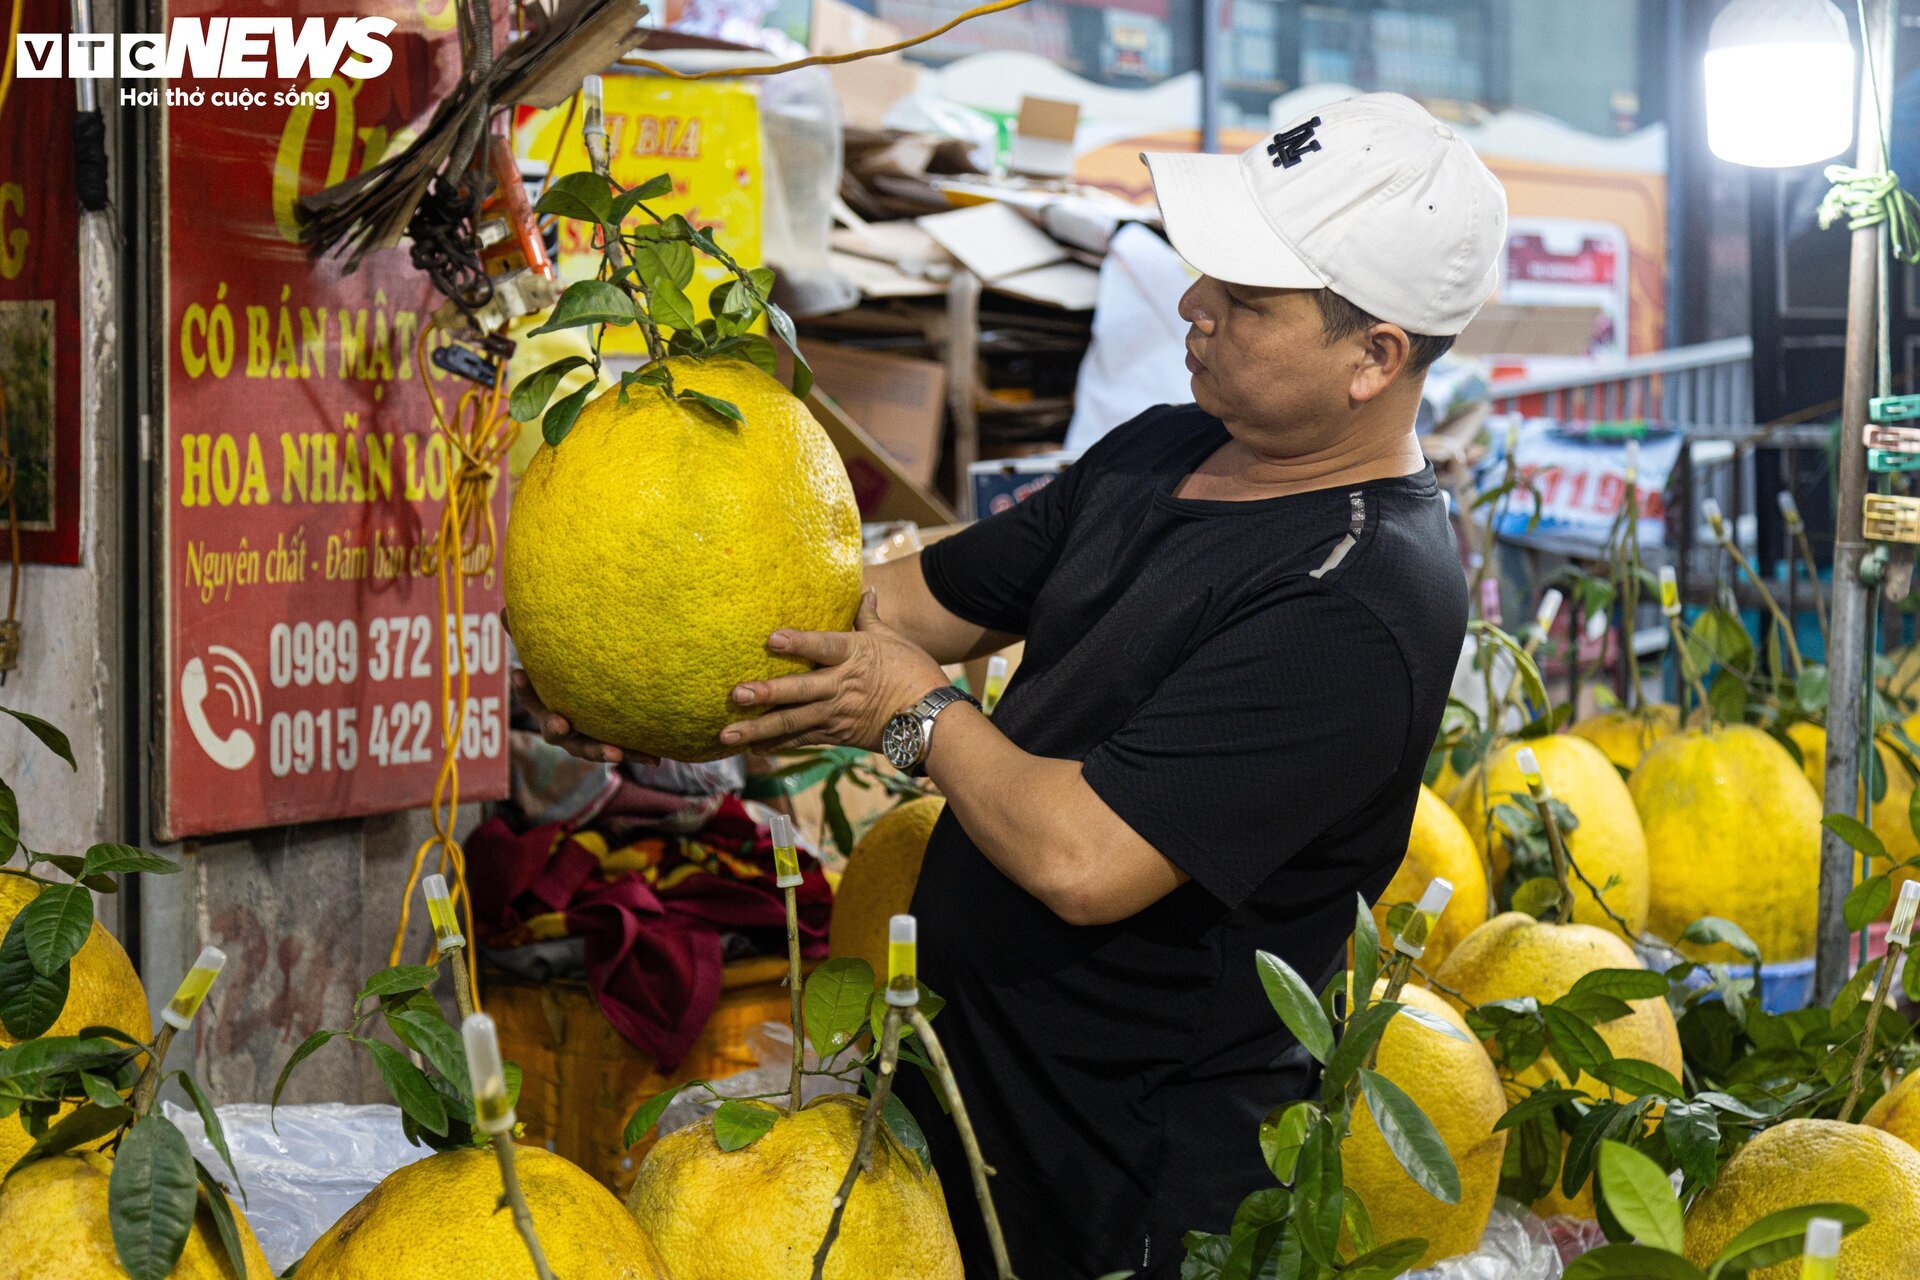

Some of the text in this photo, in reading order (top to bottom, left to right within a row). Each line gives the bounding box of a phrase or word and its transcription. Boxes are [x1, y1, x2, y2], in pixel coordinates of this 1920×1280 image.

[181, 282, 235, 379] CÓ
[246, 284, 328, 379] BÁN
[338, 288, 417, 401] MẬT
[181, 432, 270, 507] HOA
[280, 411, 394, 504] NHÃN
[185, 536, 260, 604] Nguyên
[265, 525, 306, 584] chất
[325, 529, 368, 581] Đảm
[269, 619, 359, 688] 0989
[368, 615, 432, 682] 372
[269, 709, 359, 778] 0915
[368, 700, 432, 767] 422
